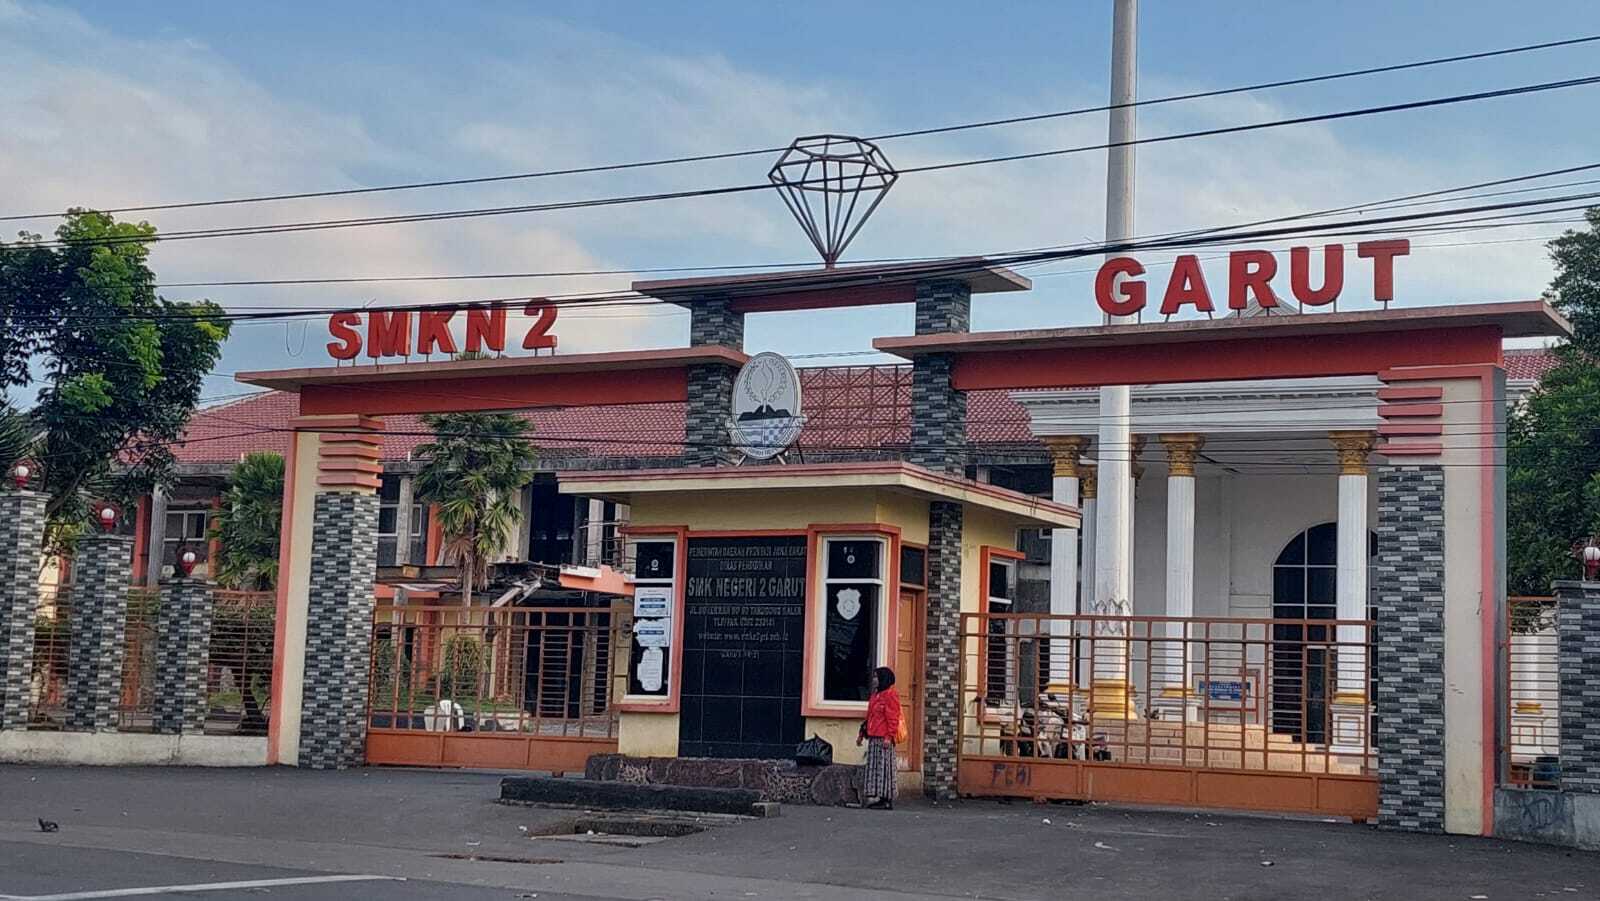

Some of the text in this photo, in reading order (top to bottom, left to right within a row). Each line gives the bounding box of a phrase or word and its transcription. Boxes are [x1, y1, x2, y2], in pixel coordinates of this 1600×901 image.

[1095, 239, 1410, 317] GARUT
[327, 298, 558, 360] SMKN 2
[688, 577, 805, 597] SMK NEGERI 2 GARUT
